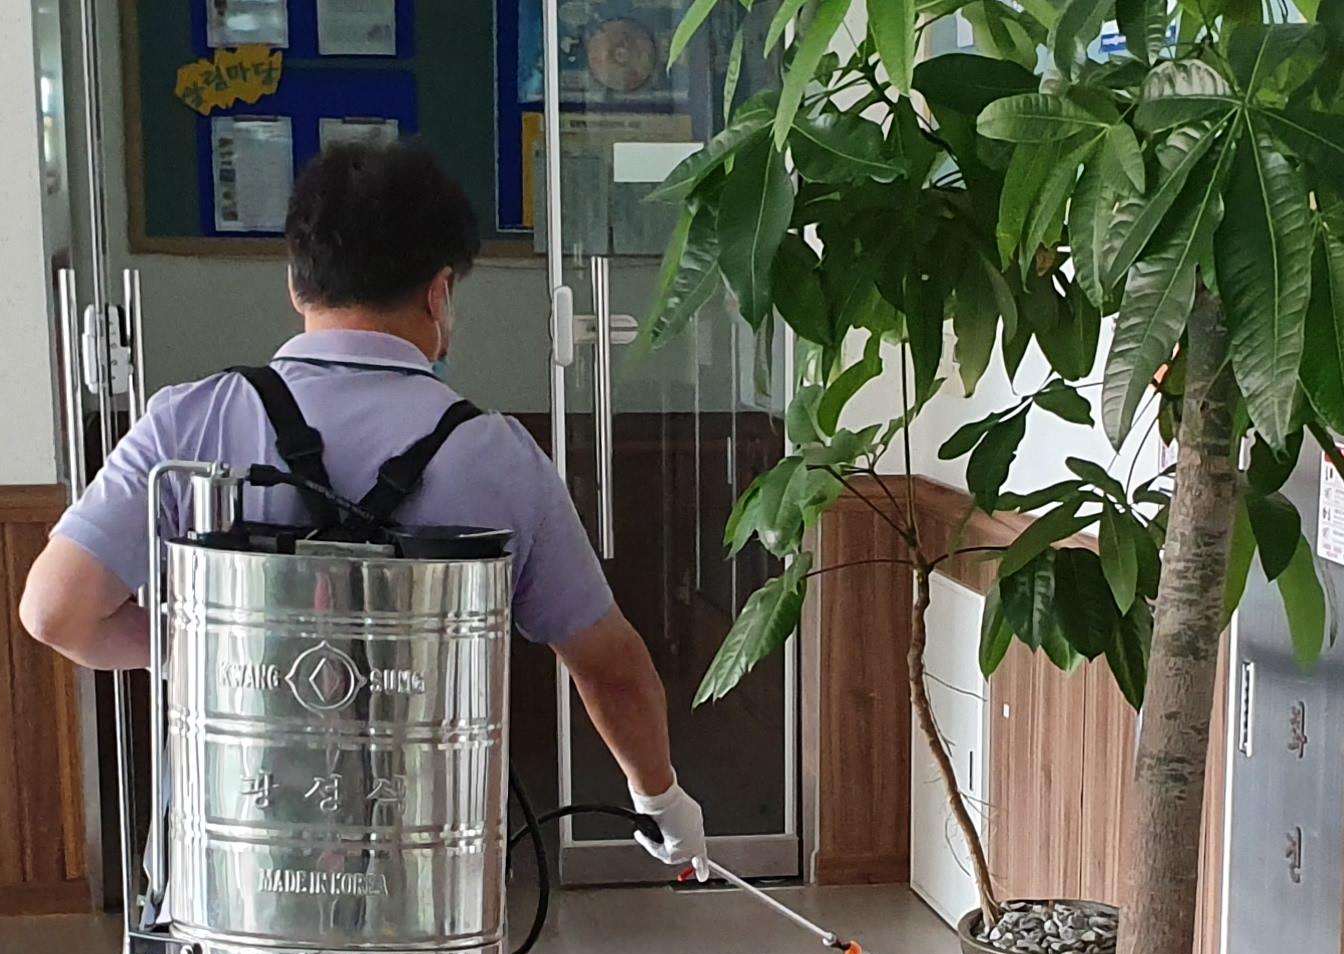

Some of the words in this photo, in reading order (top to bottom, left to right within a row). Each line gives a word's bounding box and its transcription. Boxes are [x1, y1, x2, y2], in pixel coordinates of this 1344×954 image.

[219, 664, 279, 690] KWANG
[369, 669, 425, 693] SUNG
[258, 869, 306, 893] MADE
[309, 871, 327, 893] IN
[330, 871, 388, 896] KOREA
